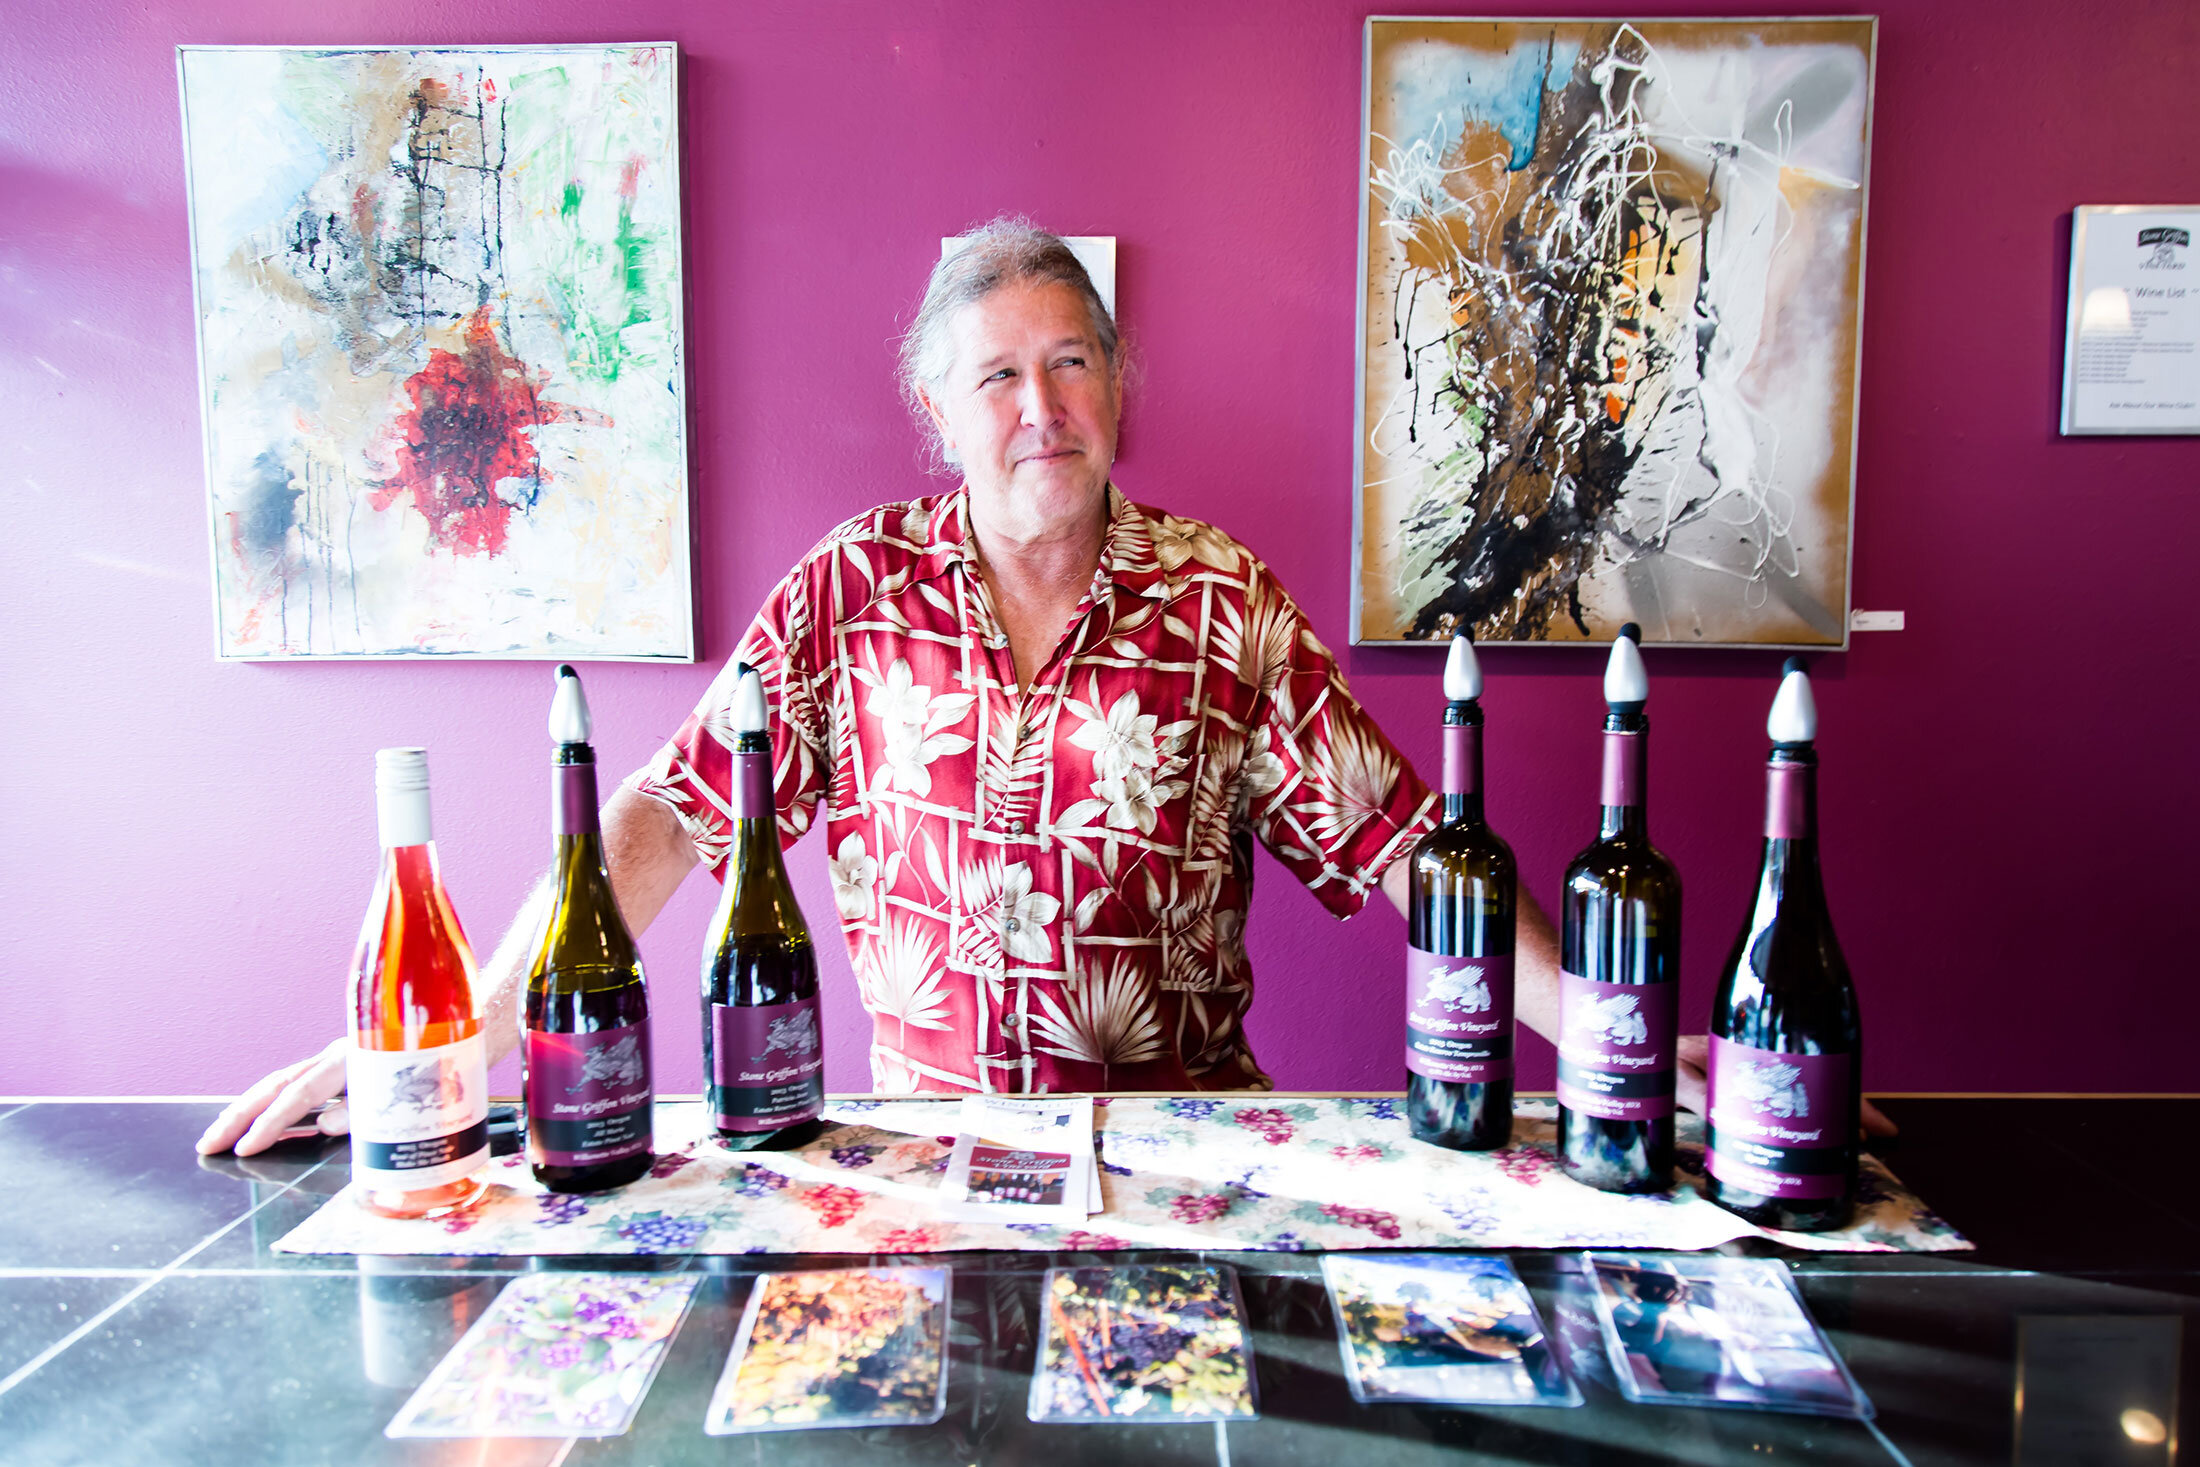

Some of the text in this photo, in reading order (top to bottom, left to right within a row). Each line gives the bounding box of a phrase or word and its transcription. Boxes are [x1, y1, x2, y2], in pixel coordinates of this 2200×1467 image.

[2136, 287, 2186, 298] Wine List
[1459, 1019, 1500, 1035] Vineyard
[1611, 1053, 1658, 1070] Vineyard
[738, 1071, 765, 1082] Stone
[552, 1102, 580, 1114] Stone
[619, 1085, 651, 1105] Vineyard
[1768, 1126, 1823, 1143] Vineyard
